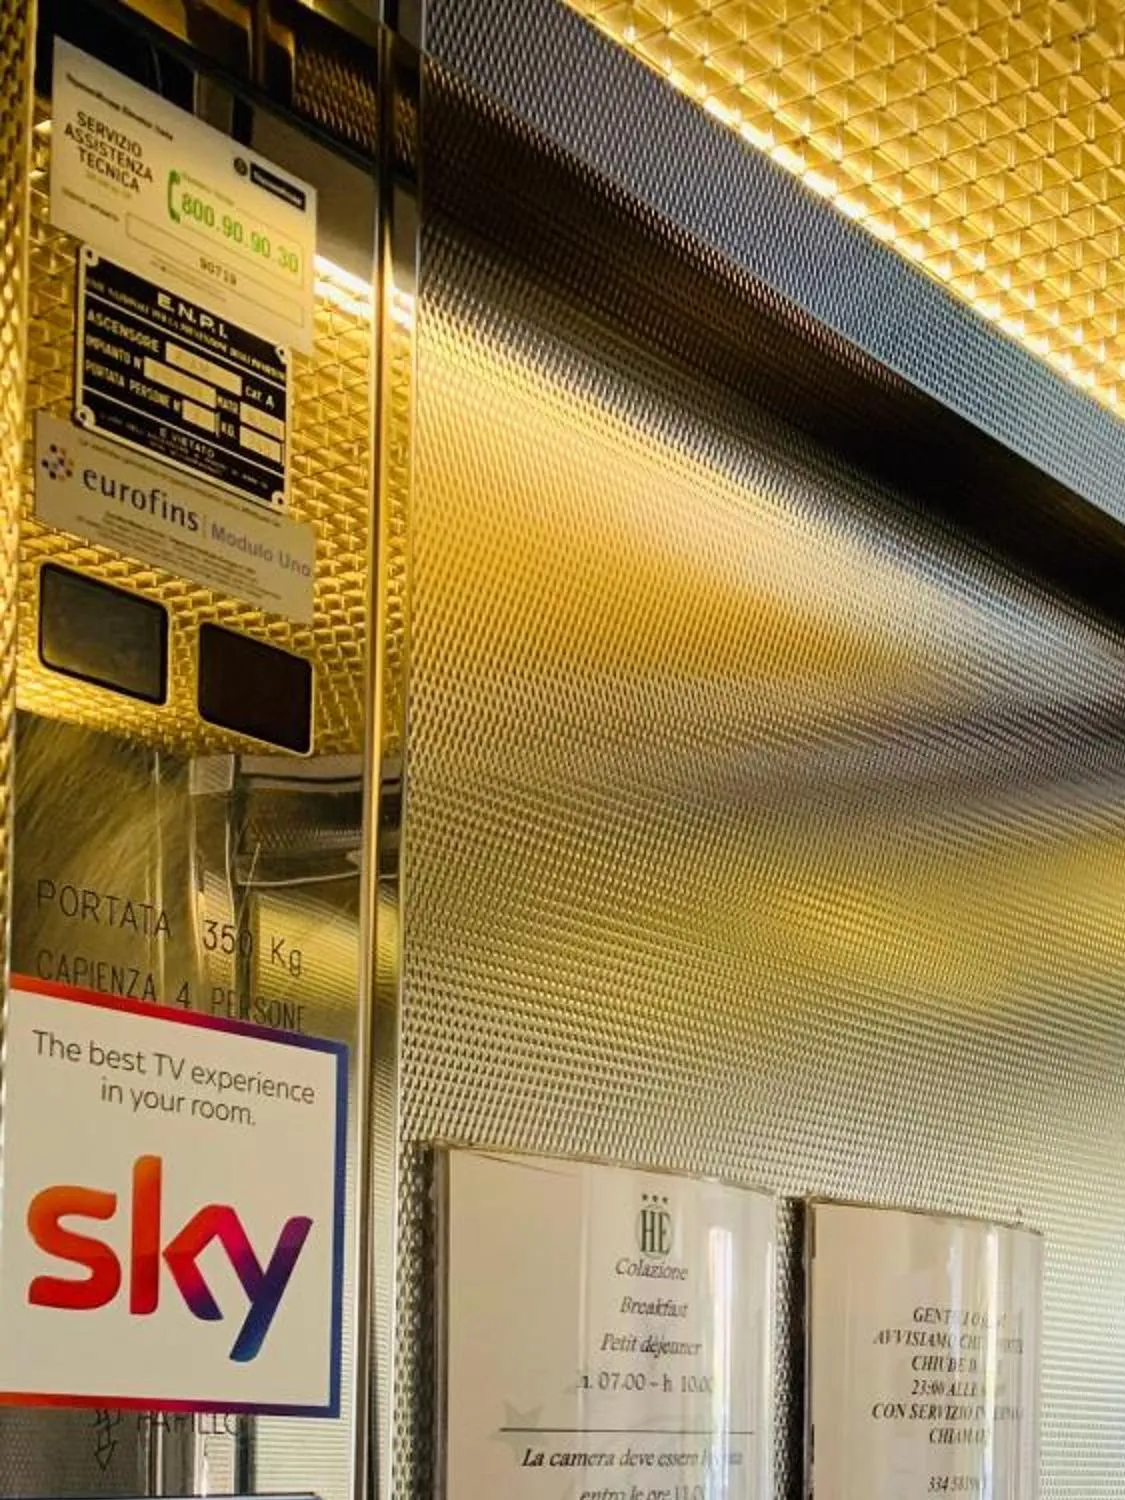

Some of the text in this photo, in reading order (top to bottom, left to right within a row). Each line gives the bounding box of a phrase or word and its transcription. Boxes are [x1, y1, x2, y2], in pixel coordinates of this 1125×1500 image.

[65, 123, 153, 182] ASSISTENZA
[77, 111, 142, 157] SERVIZIO
[77, 146, 139, 192] TECNICA
[83, 469, 200, 532] eurofins
[211, 523, 311, 577] Modulo Uno
[36, 879, 303, 978] PORTATA 350 Kg
[37, 950, 305, 1031] CAPIENZA 4 PERSONE
[33, 1029, 315, 1105] The best TV experience
[100, 1077, 257, 1127] in your room.
[27, 1155, 314, 1362] sky
[615, 1257, 688, 1281] Colazione
[619, 1296, 688, 1318] Breakfast
[600, 1333, 637, 1352] Petit
[872, 1403, 905, 1420] CON
[909, 1403, 973, 1420] SERVIZIO
[521, 1449, 543, 1467] La
[550, 1450, 615, 1467] camera
[619, 1447, 655, 1467] deve
